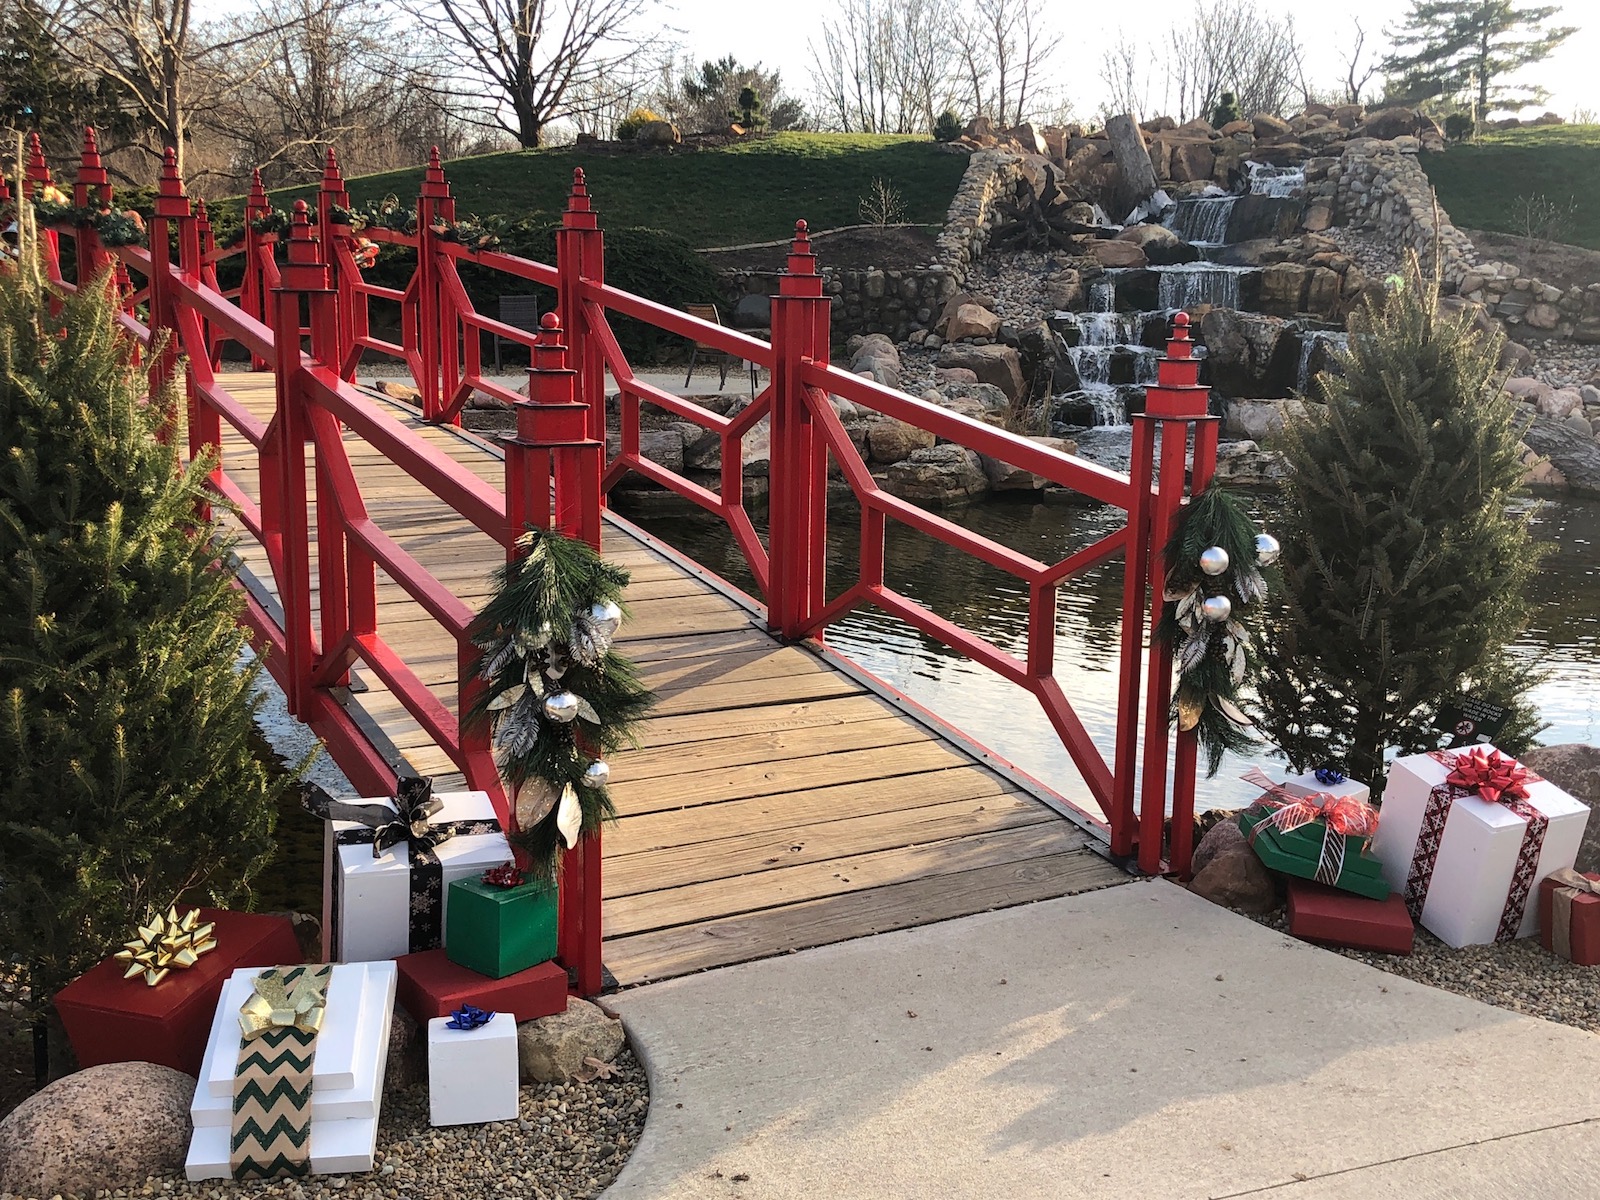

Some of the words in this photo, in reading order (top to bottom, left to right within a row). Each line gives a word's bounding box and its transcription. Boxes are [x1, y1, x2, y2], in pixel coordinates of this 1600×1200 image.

[1462, 707, 1479, 716] WADE
[1482, 708, 1502, 718] ROCKS
[1462, 712, 1483, 722] WATER
